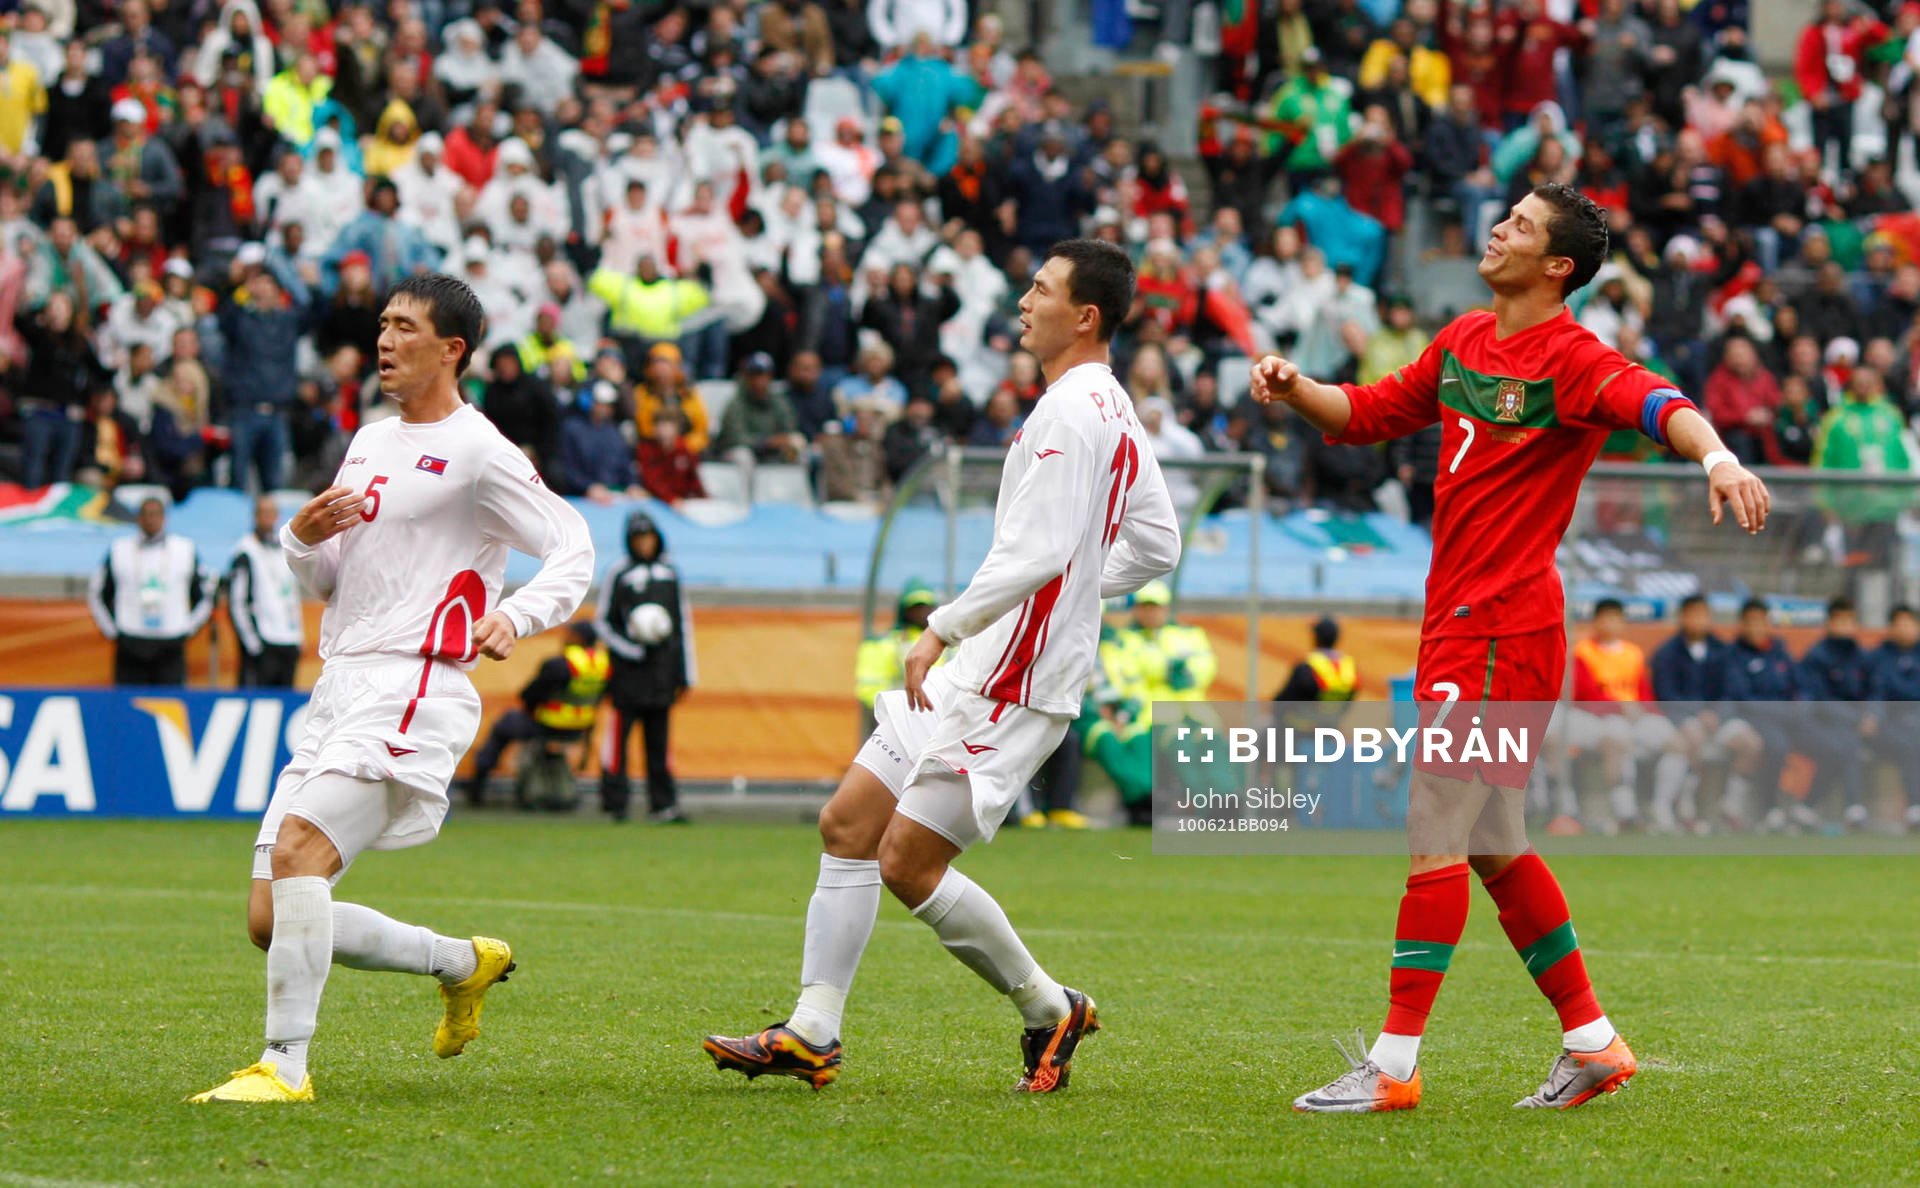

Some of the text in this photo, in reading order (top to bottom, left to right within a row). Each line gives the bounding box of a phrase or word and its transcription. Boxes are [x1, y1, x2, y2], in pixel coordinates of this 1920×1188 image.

[1449, 417, 1475, 474] 7
[360, 475, 389, 523] 5
[1431, 681, 1460, 729] 7
[0, 695, 97, 812] A
